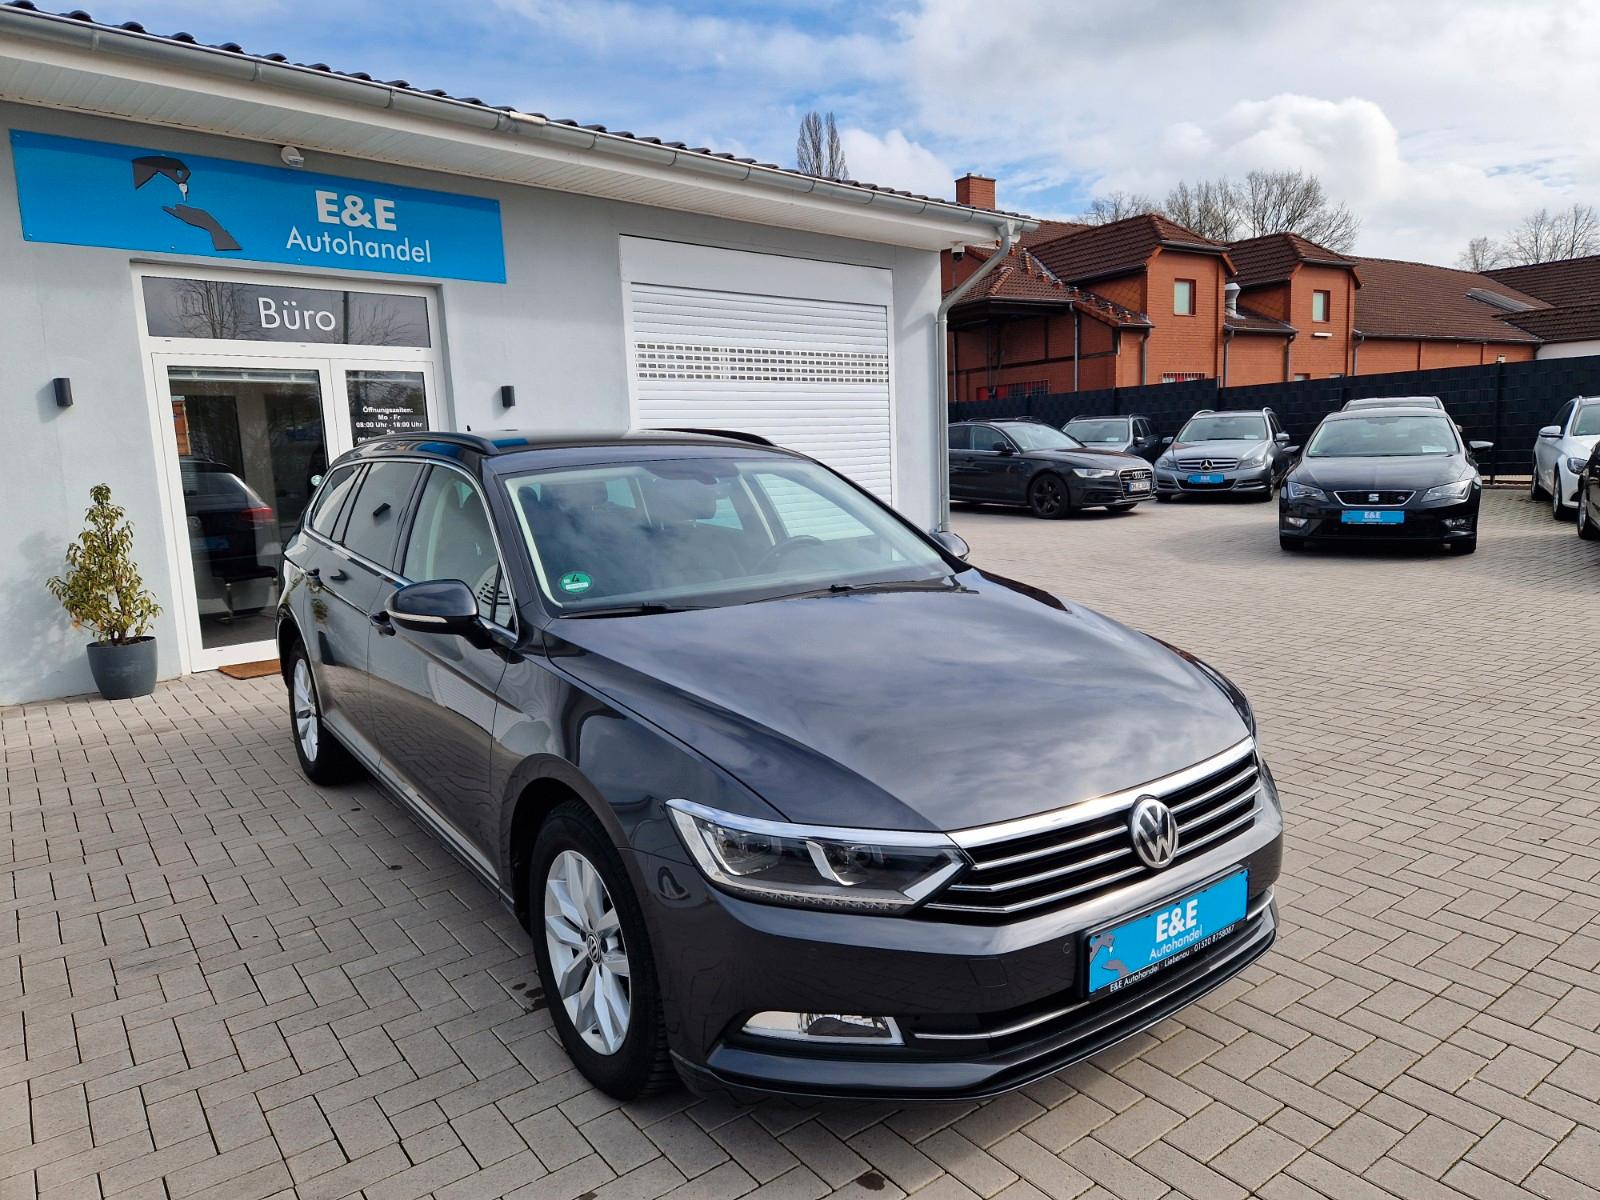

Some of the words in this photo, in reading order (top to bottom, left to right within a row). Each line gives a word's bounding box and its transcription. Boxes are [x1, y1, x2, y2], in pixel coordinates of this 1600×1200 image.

[315, 190, 397, 231] E&E
[286, 226, 431, 263] Autohandel
[258, 297, 336, 331] Büro
[363, 406, 414, 414] Öffnungszeiten:
[1156, 899, 1198, 943] E&E
[1149, 924, 1203, 961] Autohandel
[1109, 980, 1123, 992] E&E
[1124, 963, 1159, 986] Autohandel
[1164, 950, 1190, 967] Liebenau
